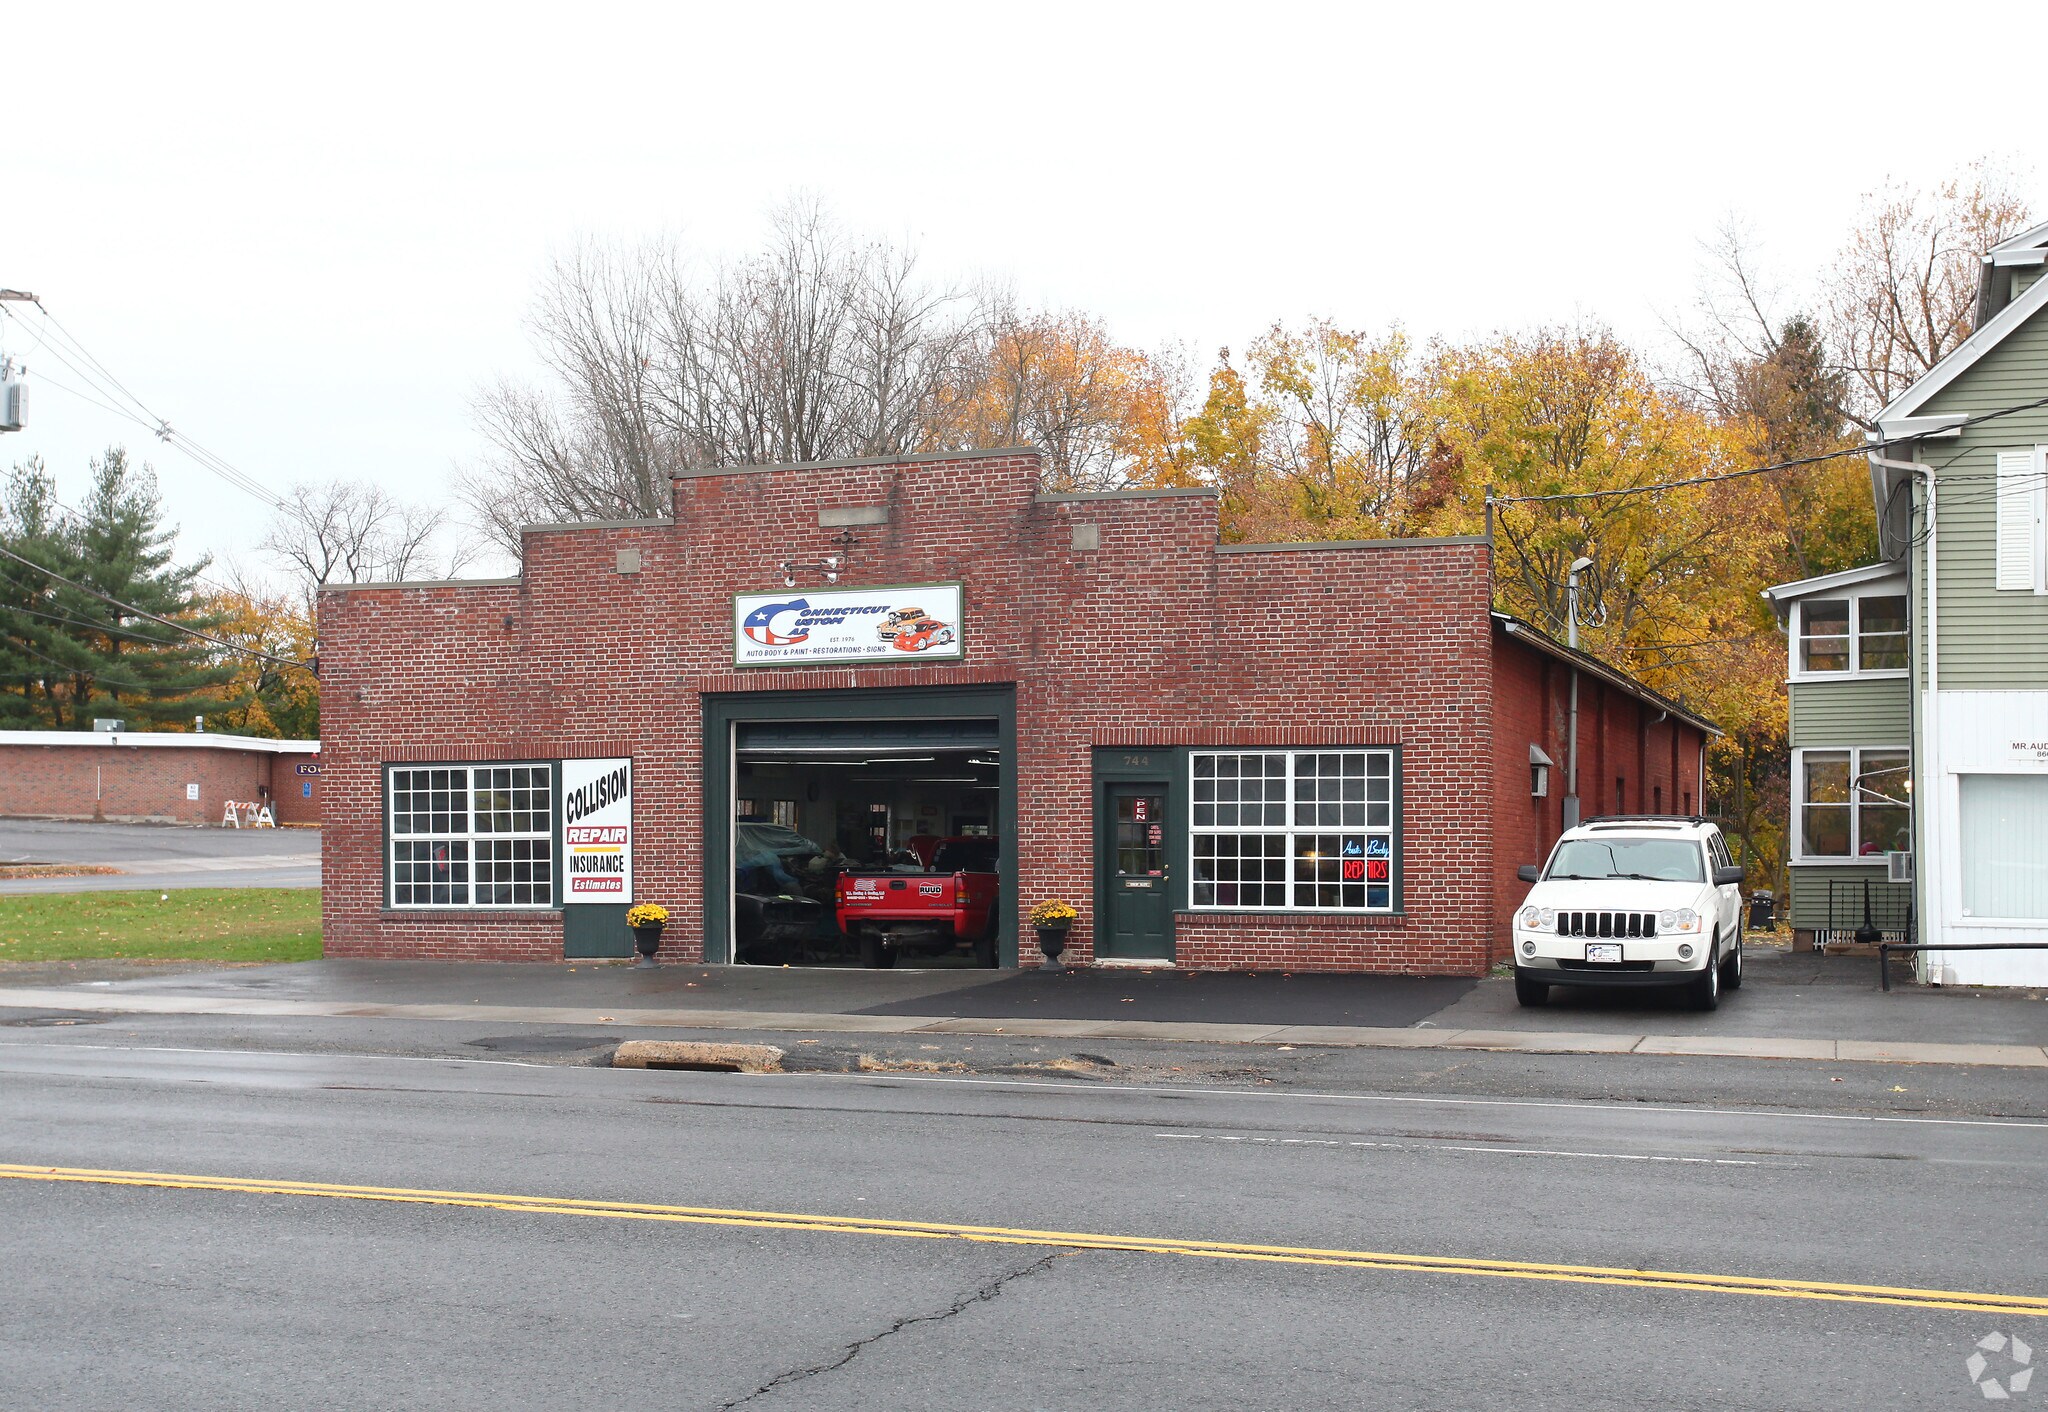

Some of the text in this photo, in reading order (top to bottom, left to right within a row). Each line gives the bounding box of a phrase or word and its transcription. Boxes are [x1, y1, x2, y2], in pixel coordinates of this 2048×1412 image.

[746, 649, 763, 657] AUTO
[764, 648, 782, 656] BODY
[812, 645, 862, 654] RESTORATIONS
[866, 645, 886, 653] SIGNS
[1123, 756, 1149, 766] 744
[300, 765, 320, 773] FO
[566, 765, 627, 825] COLLISION
[1136, 797, 1146, 820] PEN
[567, 828, 626, 843] REPAIR
[1342, 839, 1390, 858] Auto Body
[569, 855, 625, 873] INSURANCE
[1344, 860, 1387, 879] REPAIRS
[573, 879, 621, 890] Estimates
[919, 886, 942, 894] RUUD
